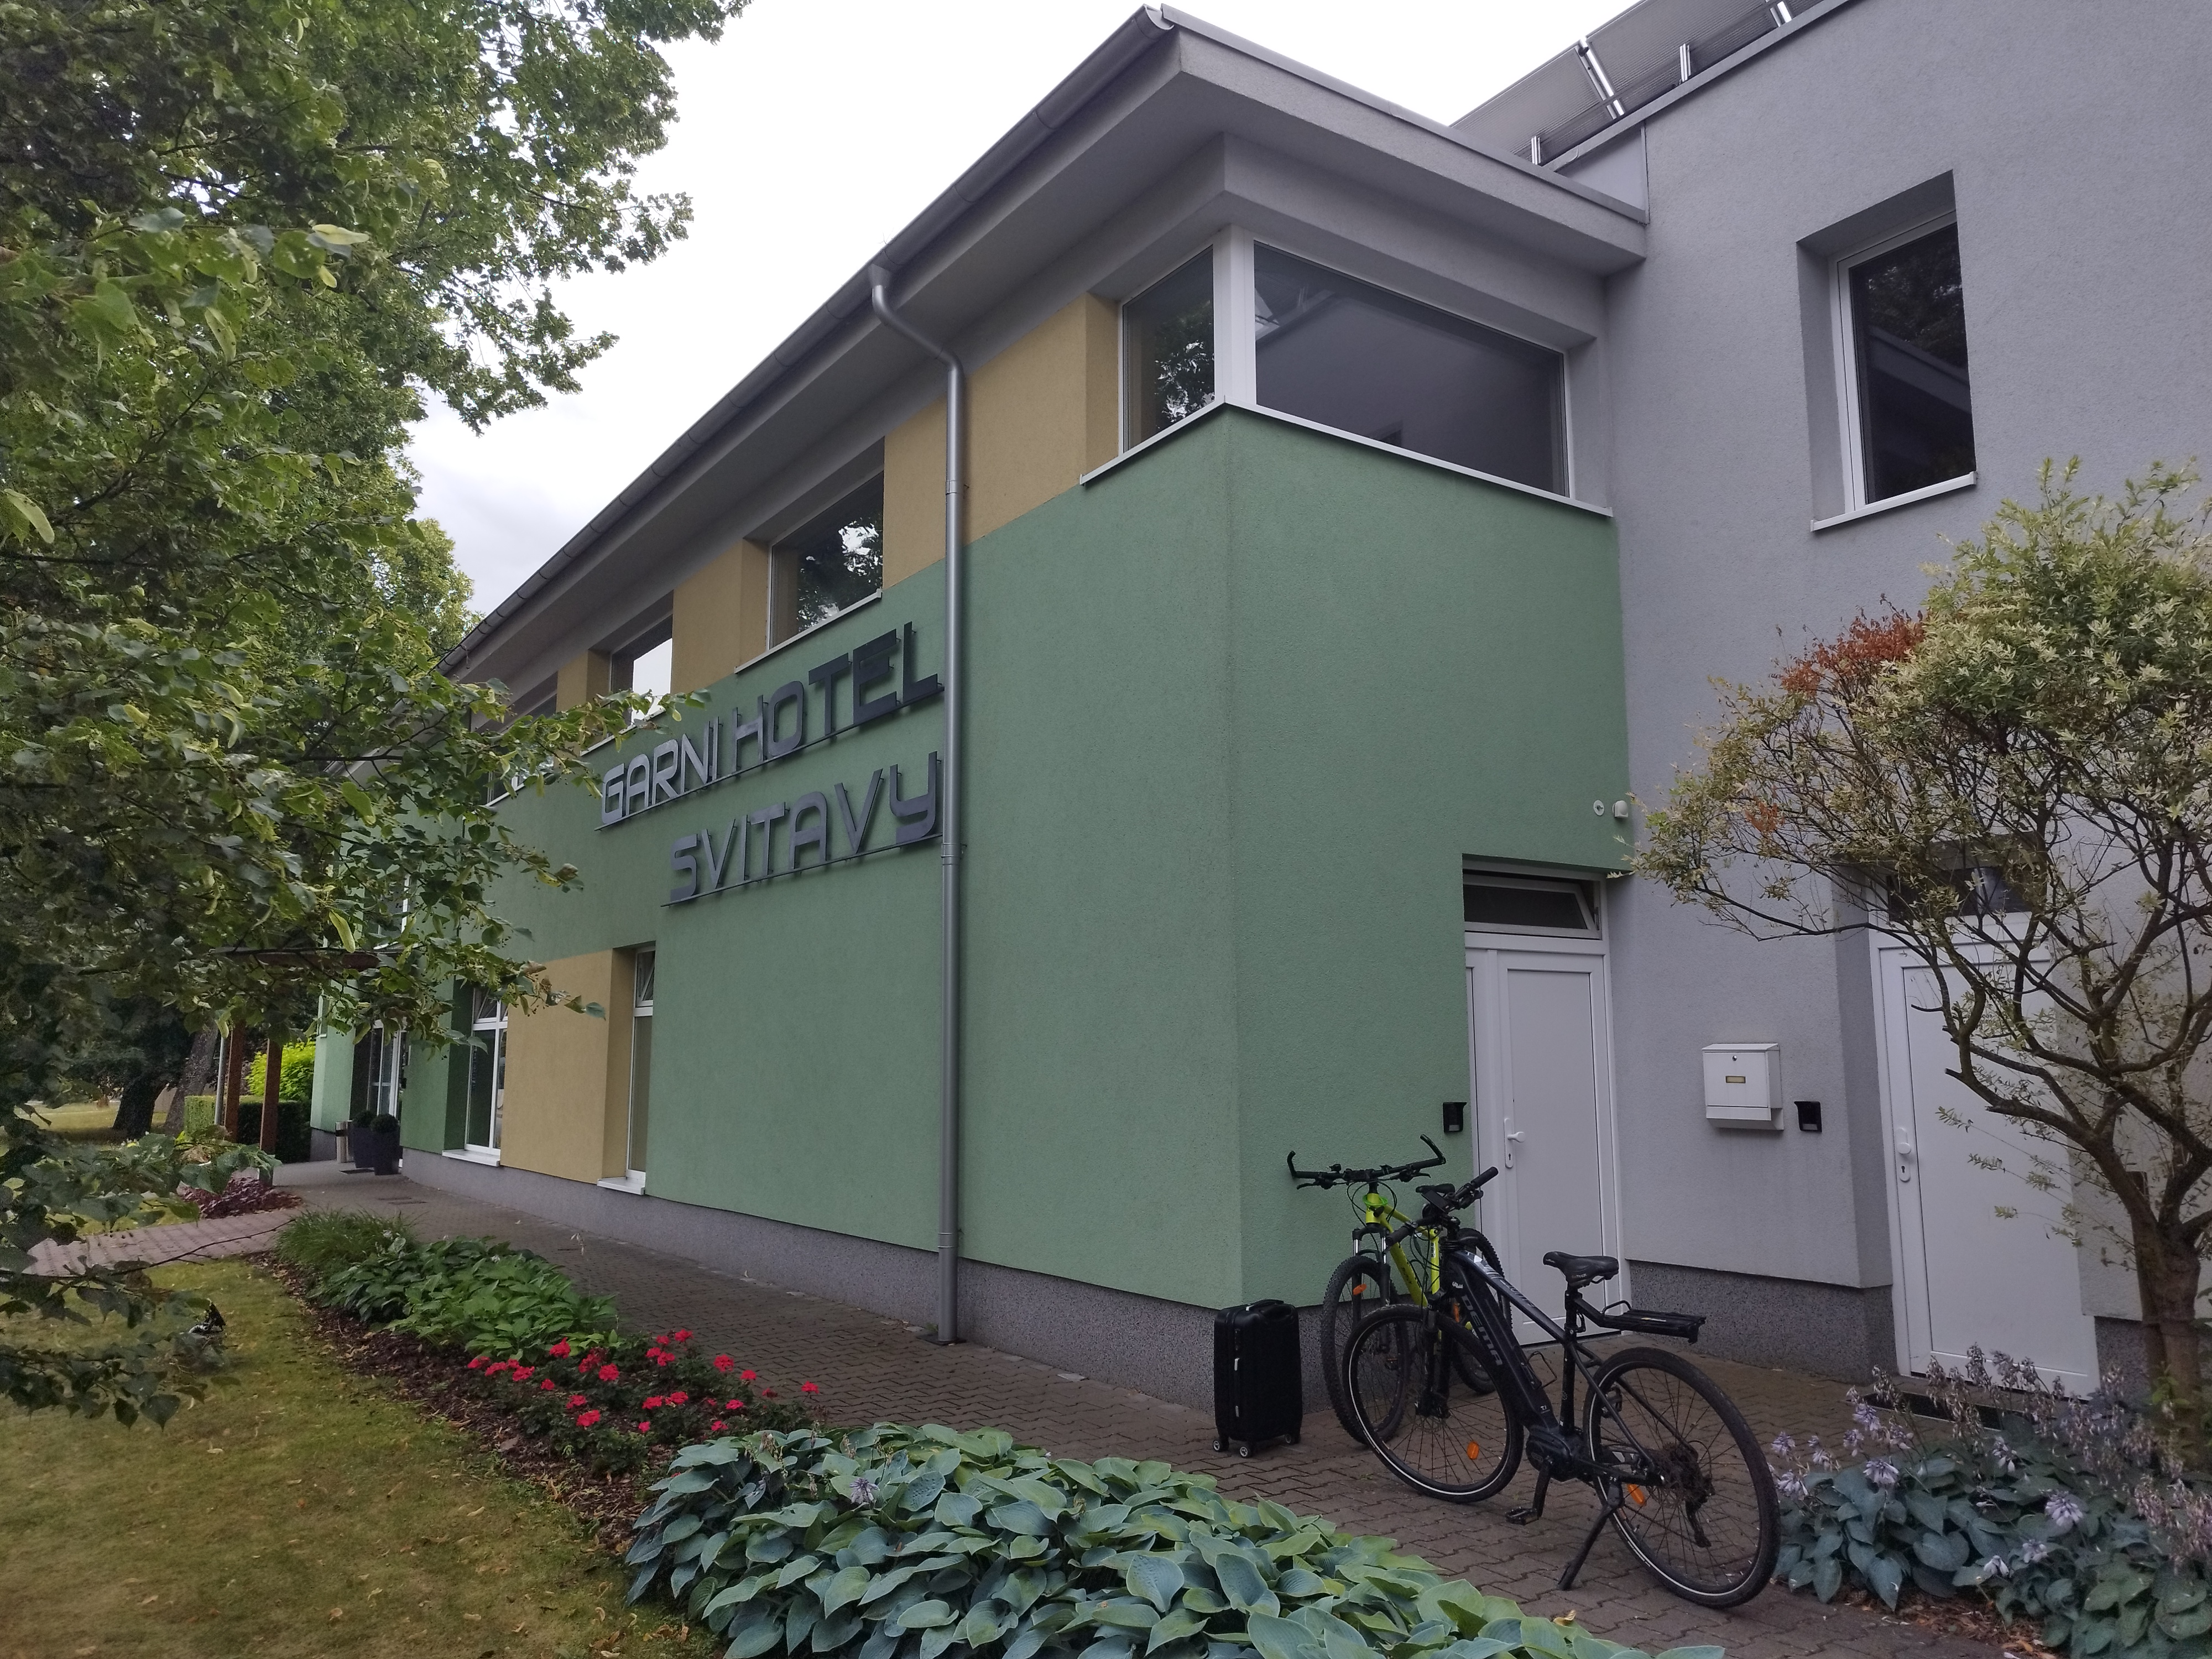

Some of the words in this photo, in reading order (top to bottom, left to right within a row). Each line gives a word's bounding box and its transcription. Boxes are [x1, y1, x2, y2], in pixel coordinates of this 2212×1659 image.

[602, 717, 719, 823] GARNI
[732, 622, 938, 771] HOTEL
[670, 751, 938, 902] SVITAVY
[1462, 1295, 1503, 1365] DEMA
